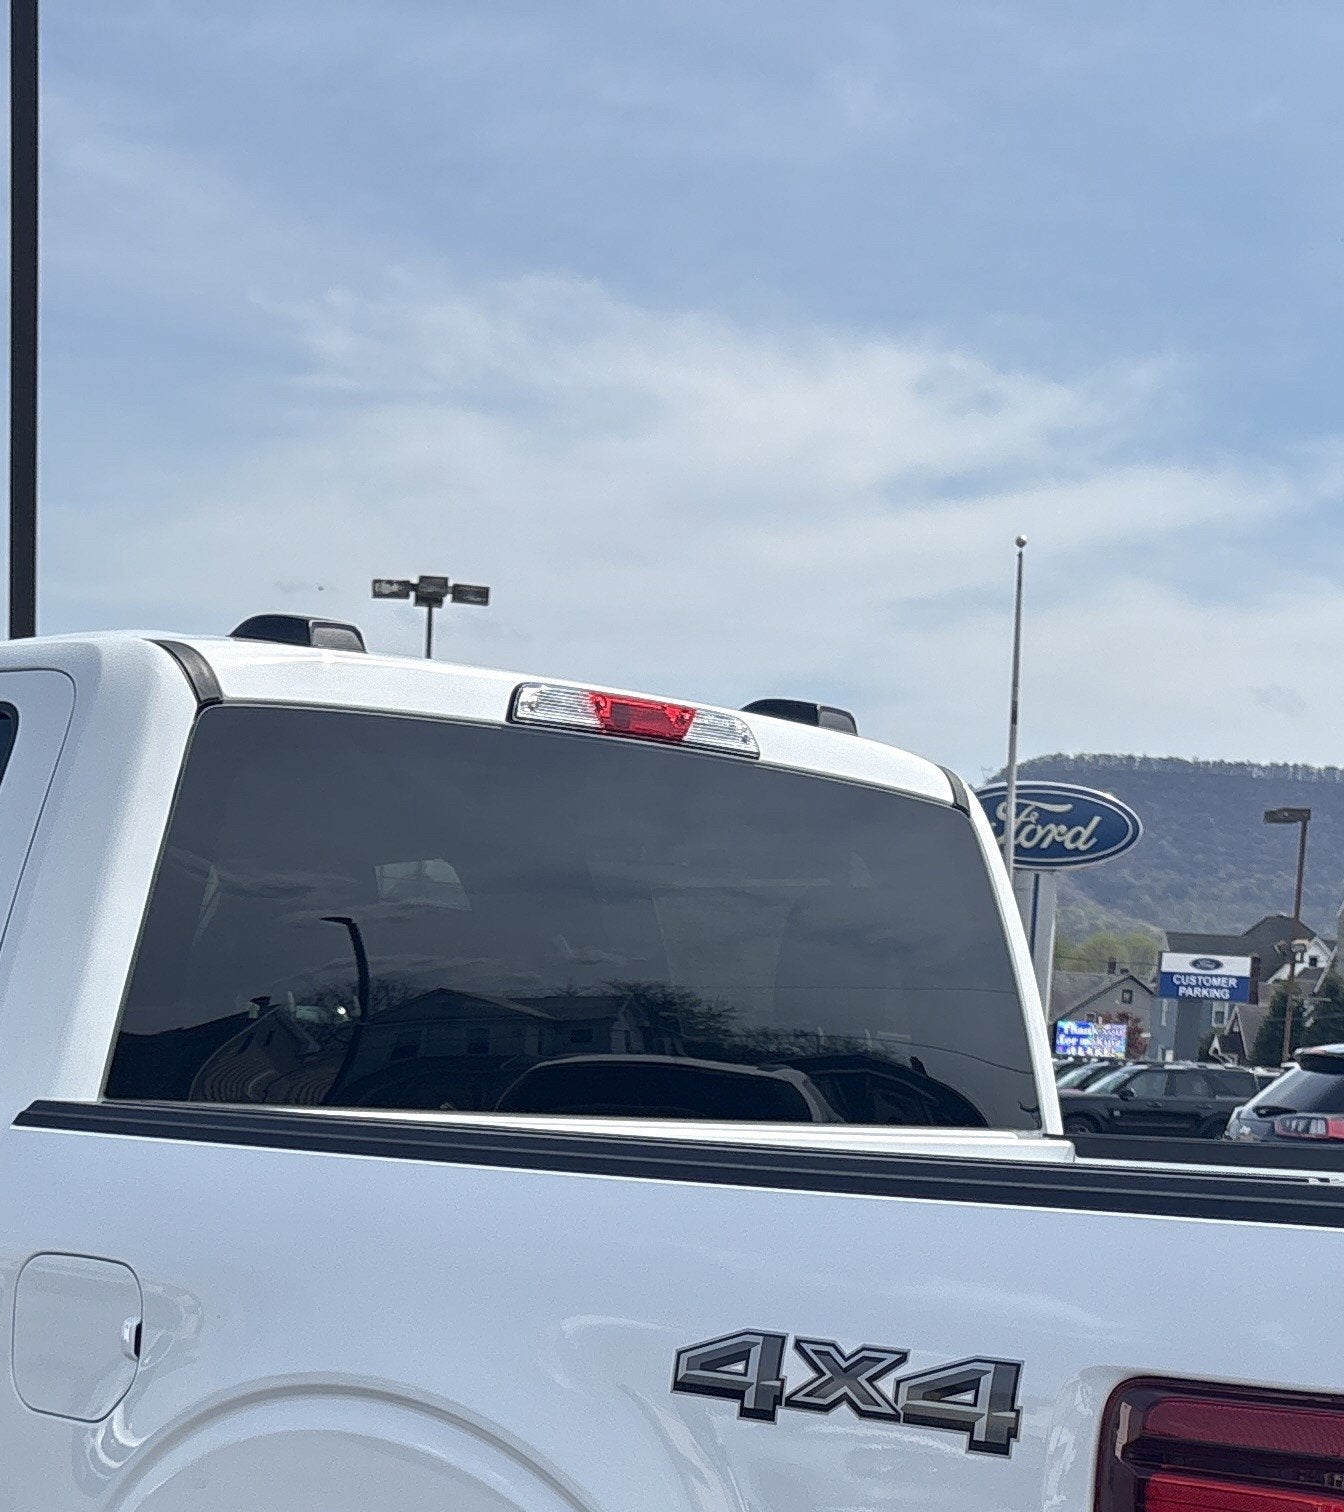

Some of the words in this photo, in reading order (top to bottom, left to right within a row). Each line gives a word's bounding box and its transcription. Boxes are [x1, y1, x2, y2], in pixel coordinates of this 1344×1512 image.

[991, 799, 1102, 851] Ford
[1172, 974, 1238, 988] CUSTOMER
[1178, 986, 1230, 1000] PARKING
